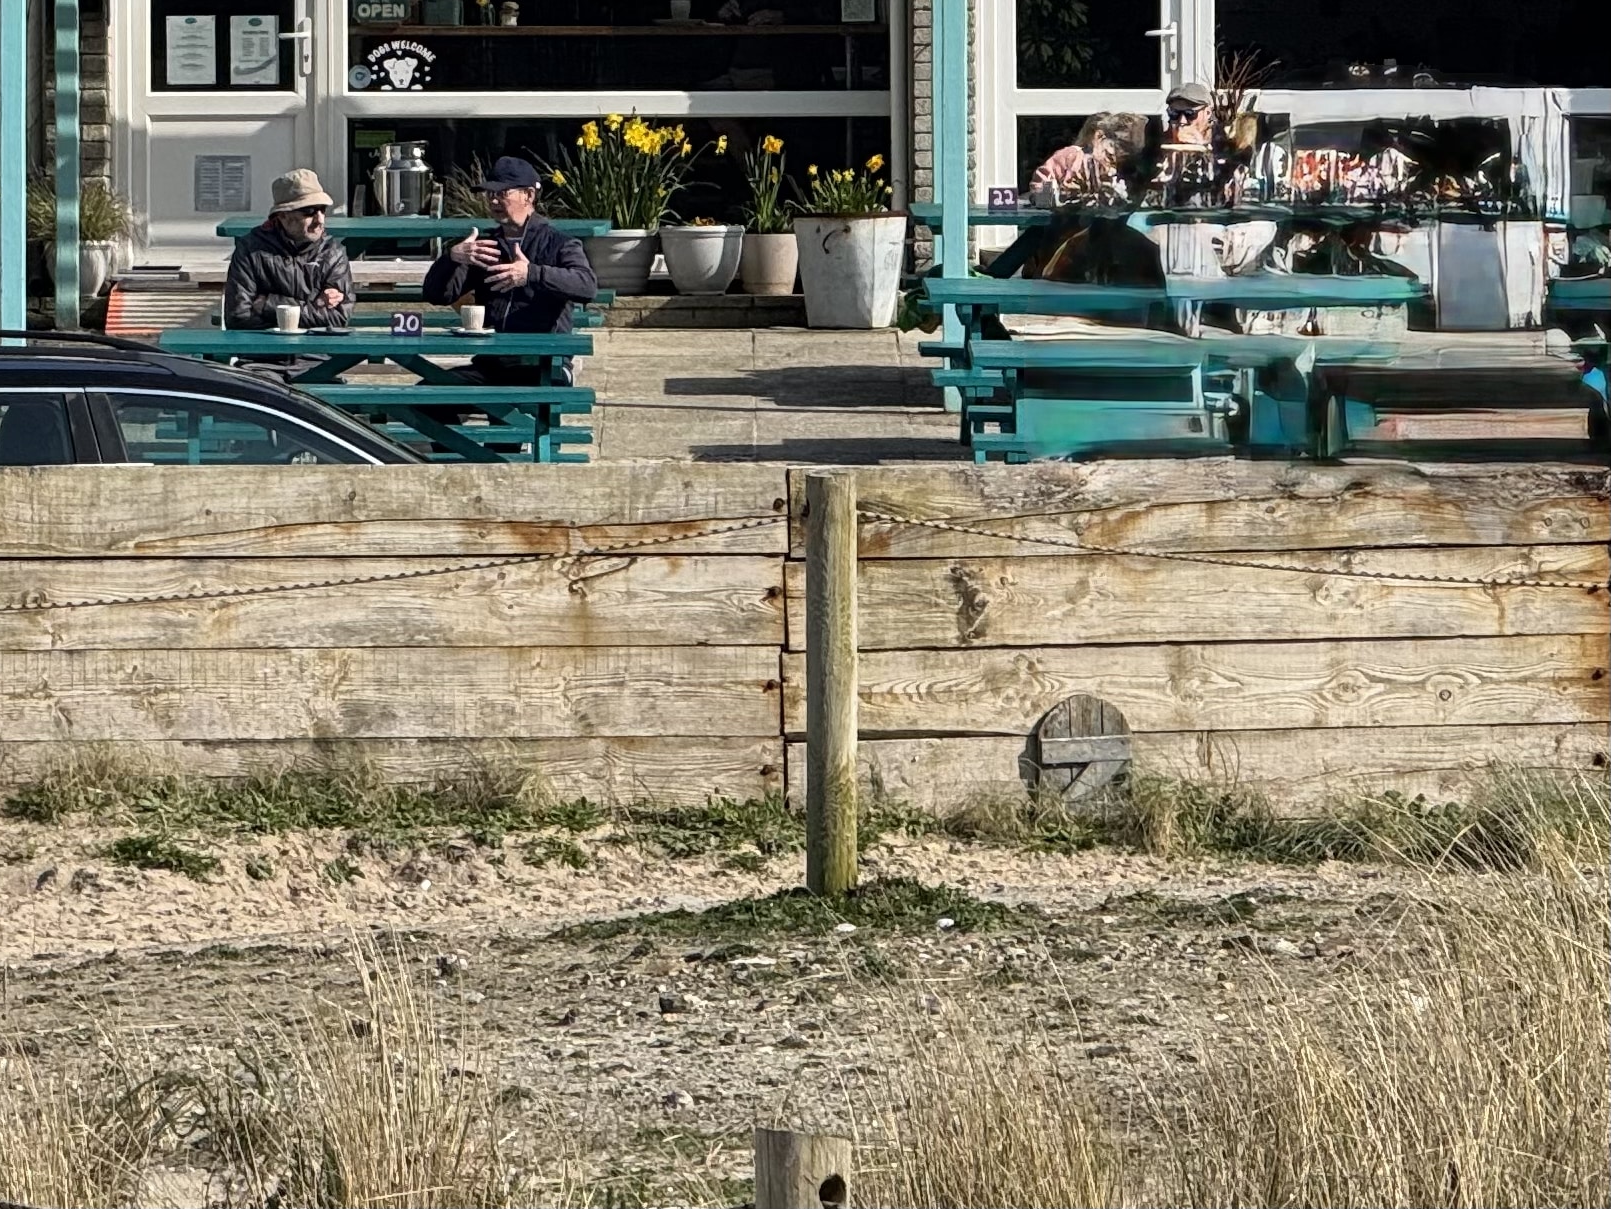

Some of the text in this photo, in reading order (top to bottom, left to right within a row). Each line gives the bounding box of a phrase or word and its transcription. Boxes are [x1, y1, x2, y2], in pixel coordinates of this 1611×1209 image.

[358, 3, 405, 18] OPEN
[367, 40, 436, 62] DOGS WELCOME
[993, 189, 1016, 206] 22
[393, 313, 420, 333] 20
